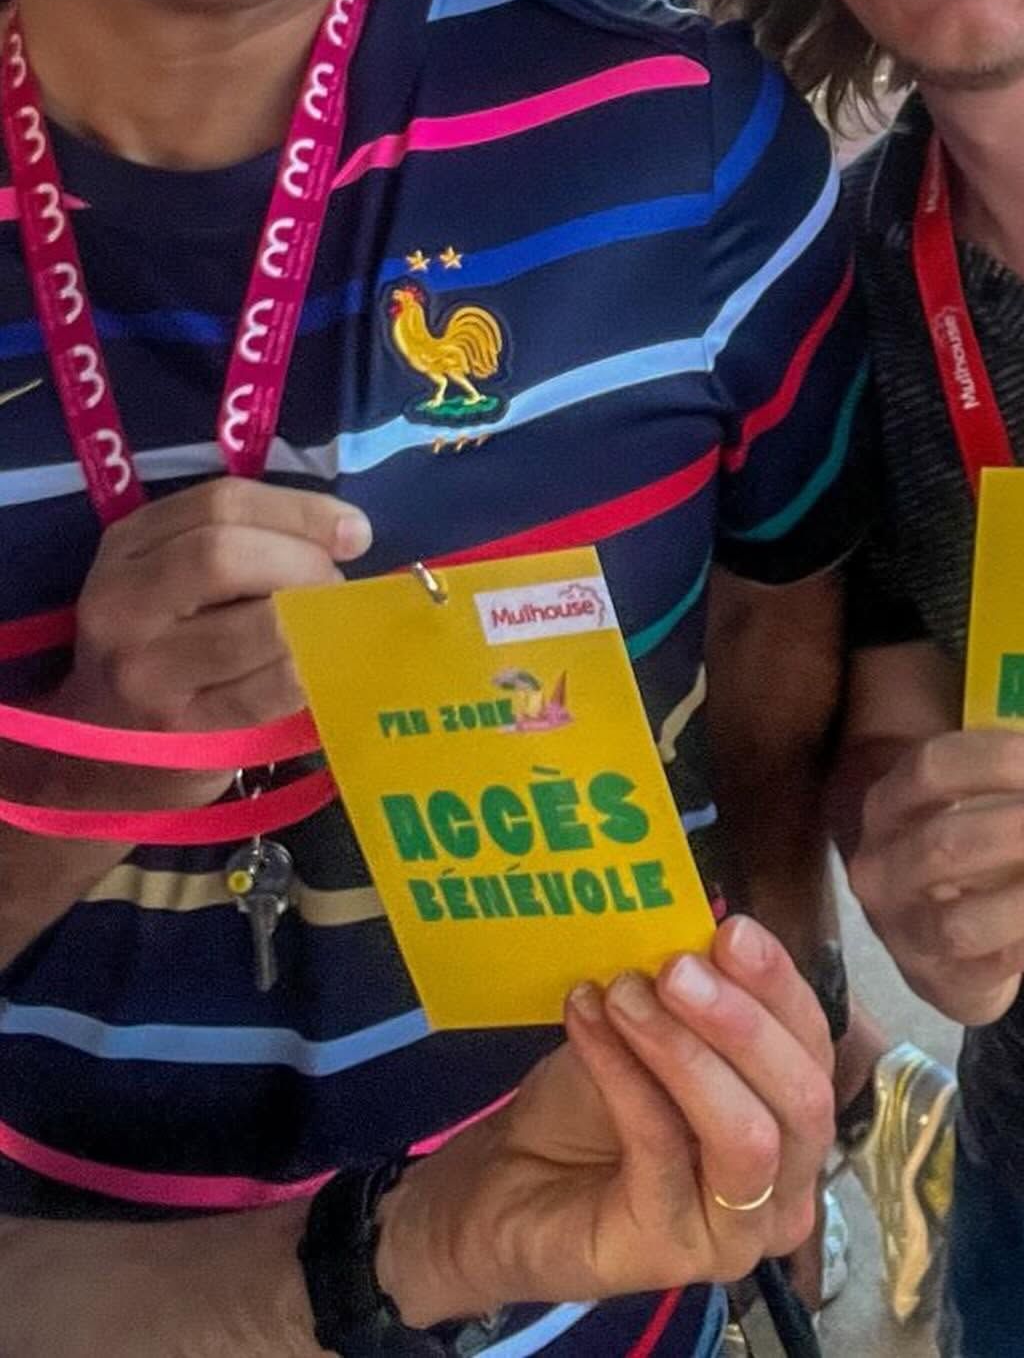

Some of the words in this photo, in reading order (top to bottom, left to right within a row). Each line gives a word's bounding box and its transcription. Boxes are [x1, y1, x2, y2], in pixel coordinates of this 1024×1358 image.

[942, 313, 981, 410] Mulhouse
[491, 598, 595, 629] Mulhouse
[378, 708, 431, 738] FAN
[439, 698, 516, 732] ZONE
[381, 765, 648, 862] ACCÈS
[408, 860, 674, 922] BÉNÉVOLE
